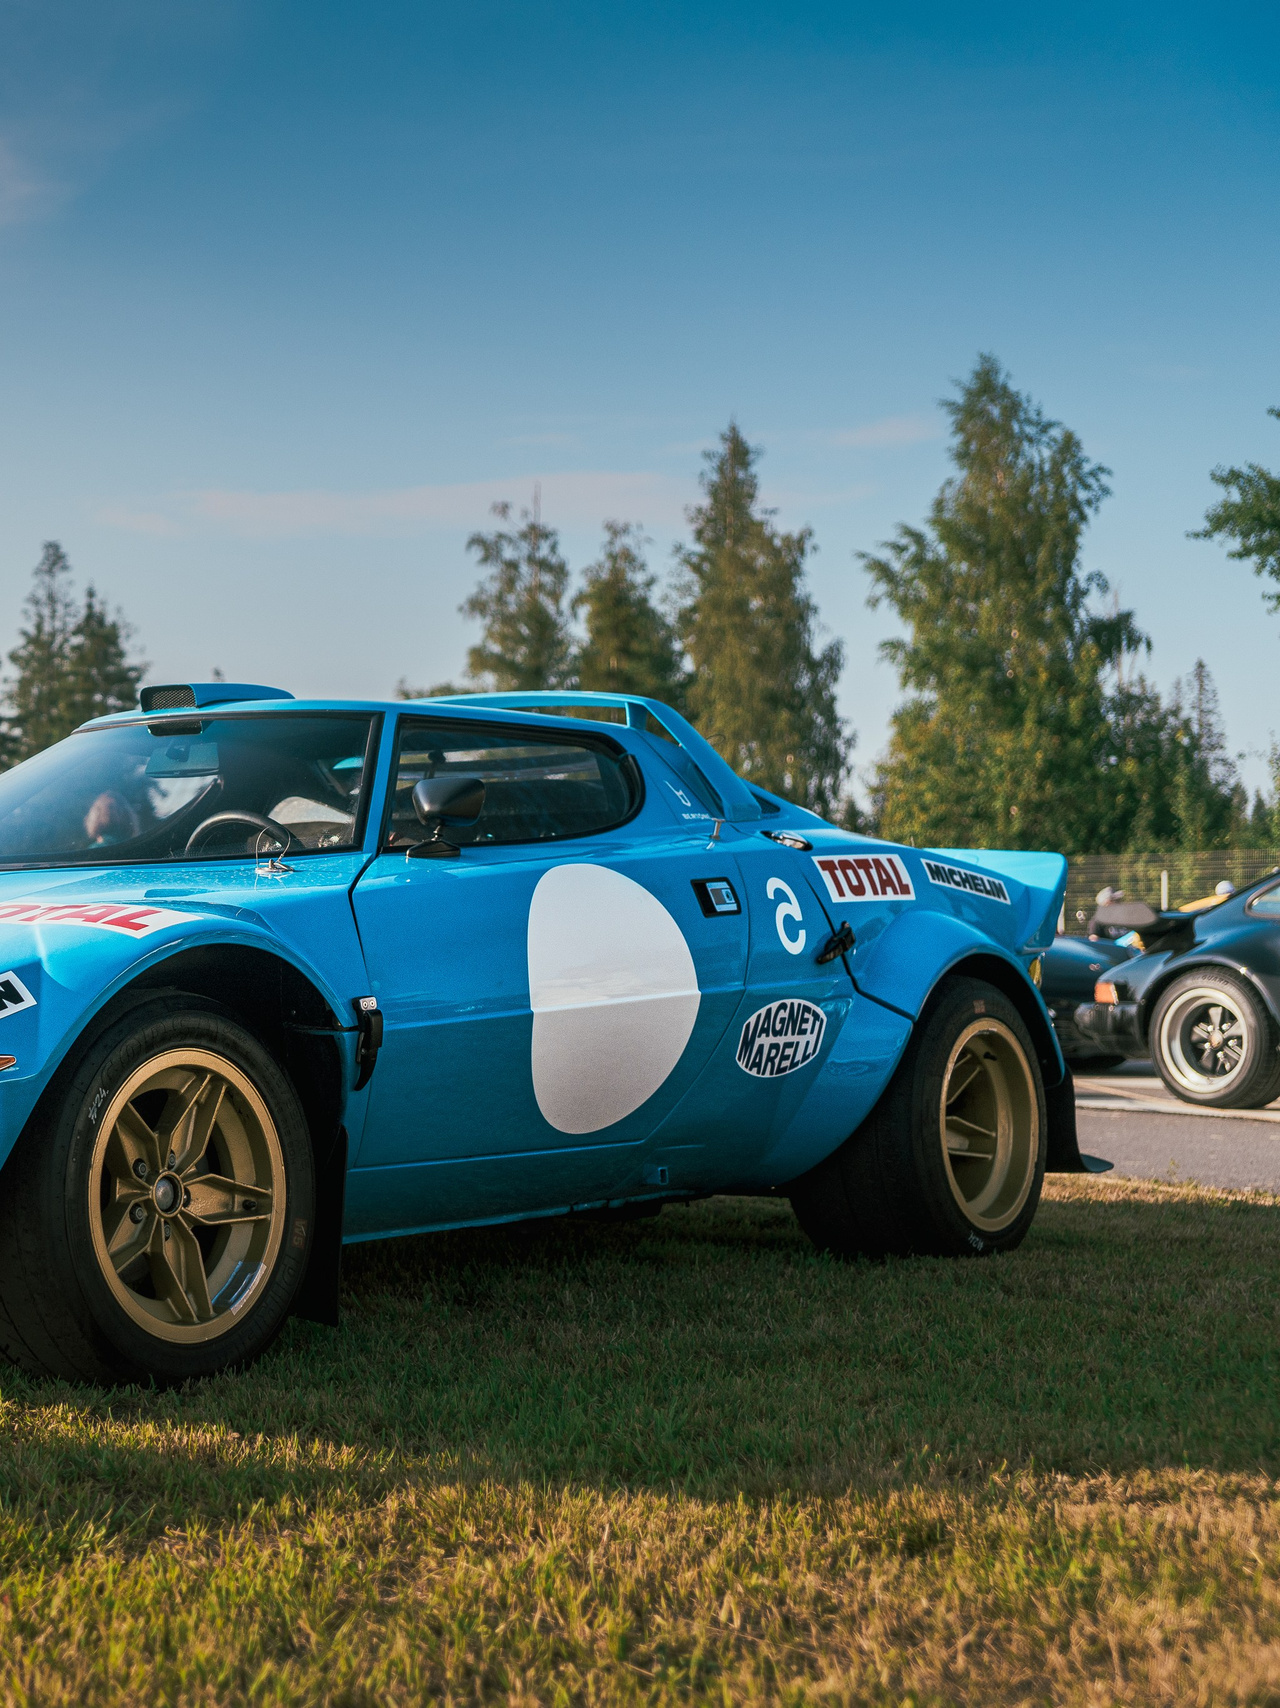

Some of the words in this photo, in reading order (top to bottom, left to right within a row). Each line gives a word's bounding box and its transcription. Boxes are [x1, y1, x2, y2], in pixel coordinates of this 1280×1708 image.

[817, 858, 911, 897] TOTAL
[925, 862, 1007, 901] MICHELIN
[739, 1002, 824, 1046] MAGNETI
[737, 1036, 821, 1076] MARELLI
